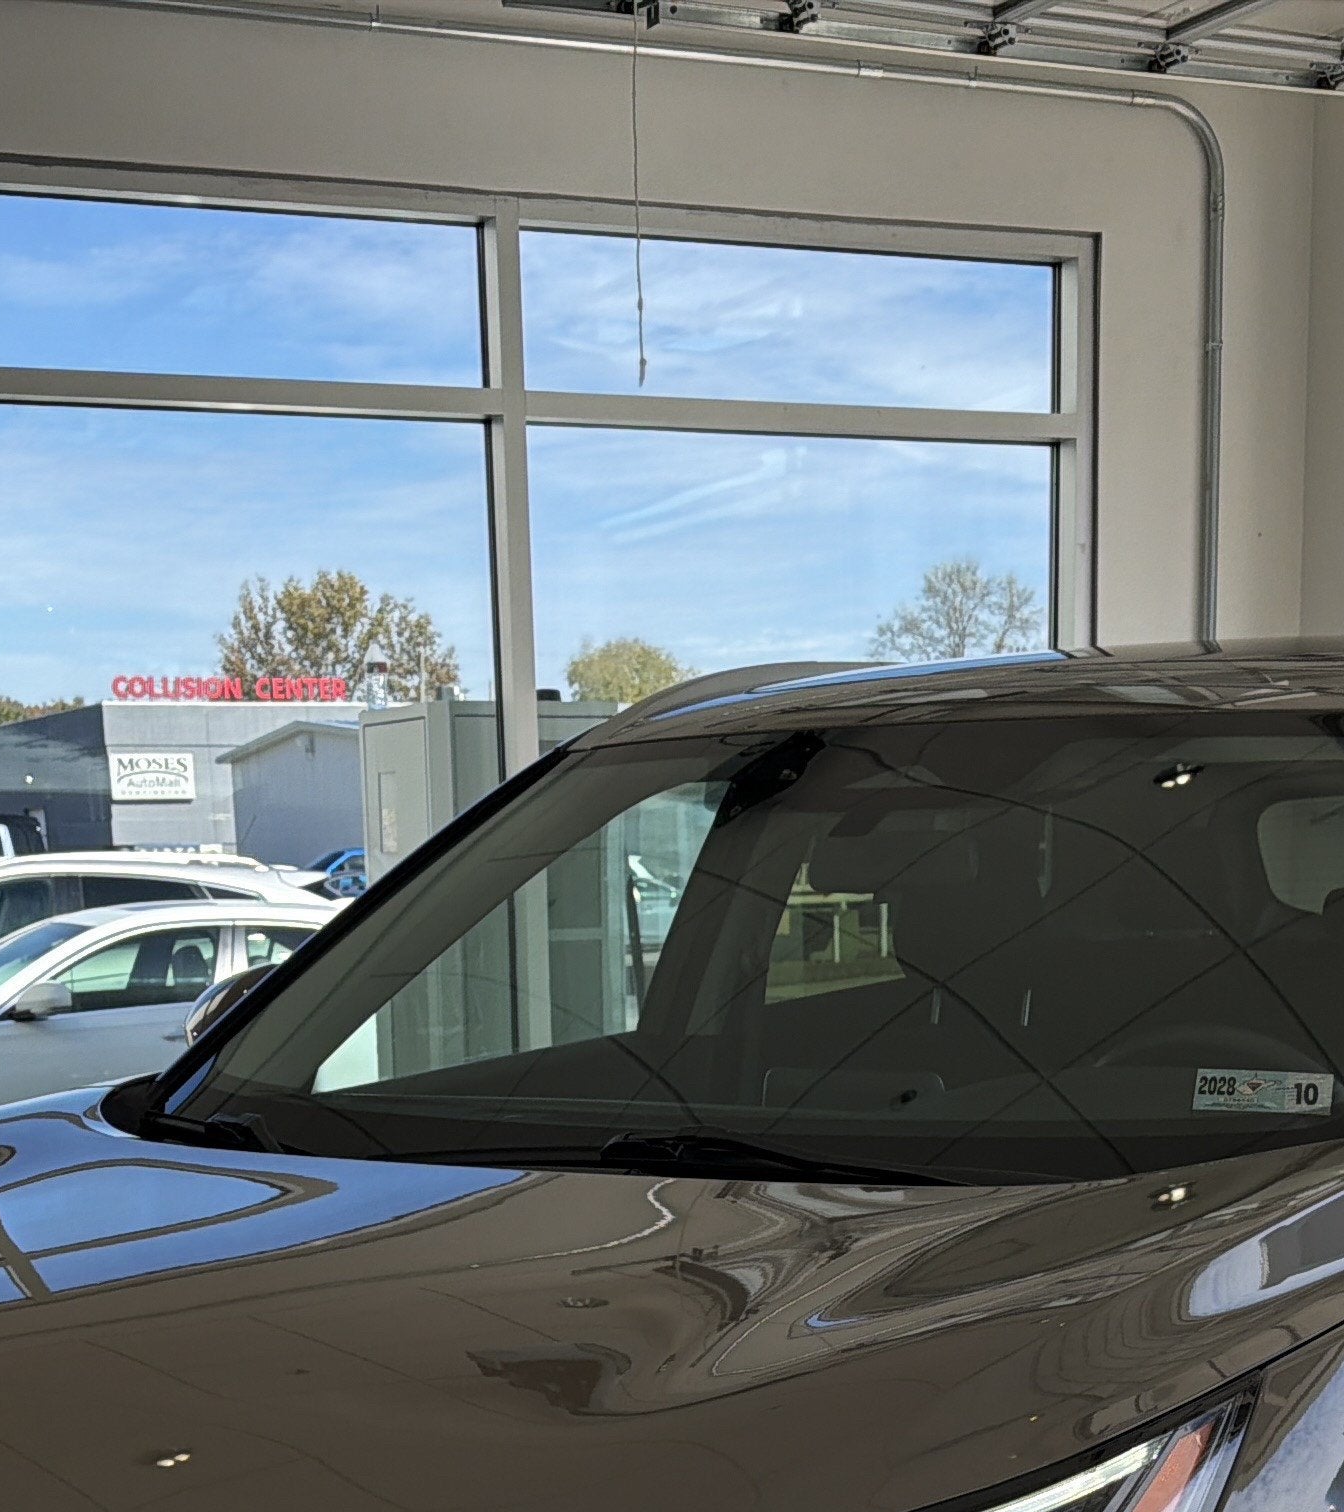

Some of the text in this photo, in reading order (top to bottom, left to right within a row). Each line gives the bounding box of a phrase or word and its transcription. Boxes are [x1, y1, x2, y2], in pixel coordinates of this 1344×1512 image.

[111, 675, 347, 700] COLLISION CENTER
[116, 755, 189, 777] MOSES
[1197, 1075, 1237, 1096] 2028
[1294, 1082, 1319, 1106] 10
